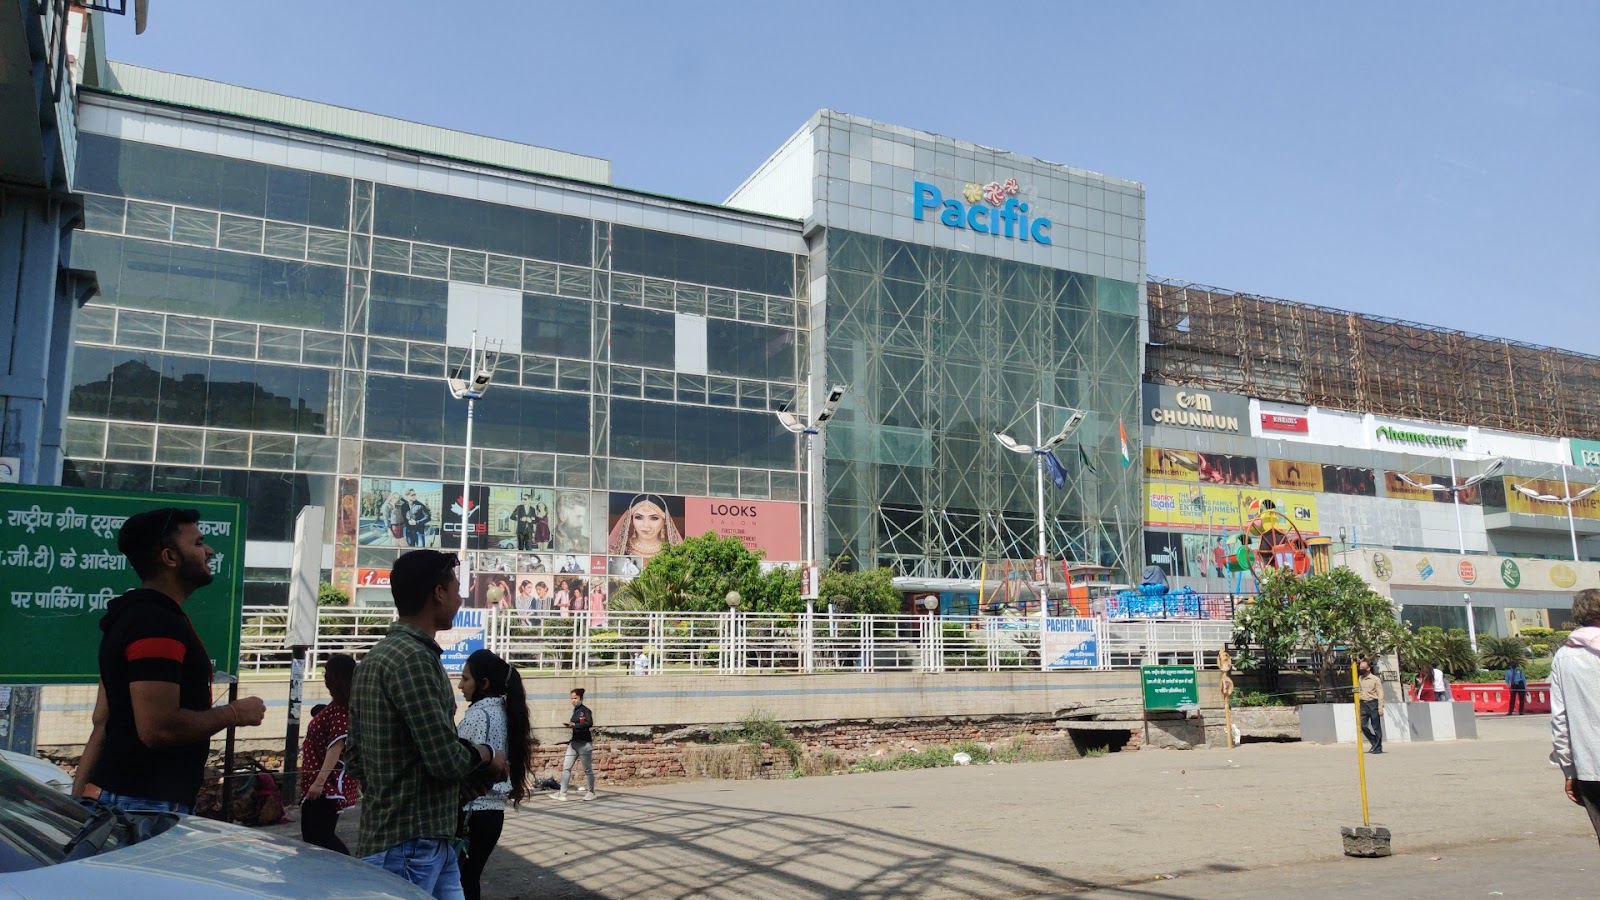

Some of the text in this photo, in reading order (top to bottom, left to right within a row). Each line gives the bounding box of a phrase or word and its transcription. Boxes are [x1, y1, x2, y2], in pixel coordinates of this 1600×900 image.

[913, 180, 1052, 245] Pacific
[1151, 408, 1238, 431] CHUNMUN
[8, 505, 53, 534] राष्ट्रीय
[56, 506, 88, 531] ग्रीन
[711, 504, 756, 517] LOOKS
[60, 547, 77, 568] के
[11, 591, 31, 609] पर
[35, 586, 85, 609] पार्किंग
[453, 611, 482, 627] MALL
[1046, 619, 1093, 632] PACIFIC MALL
